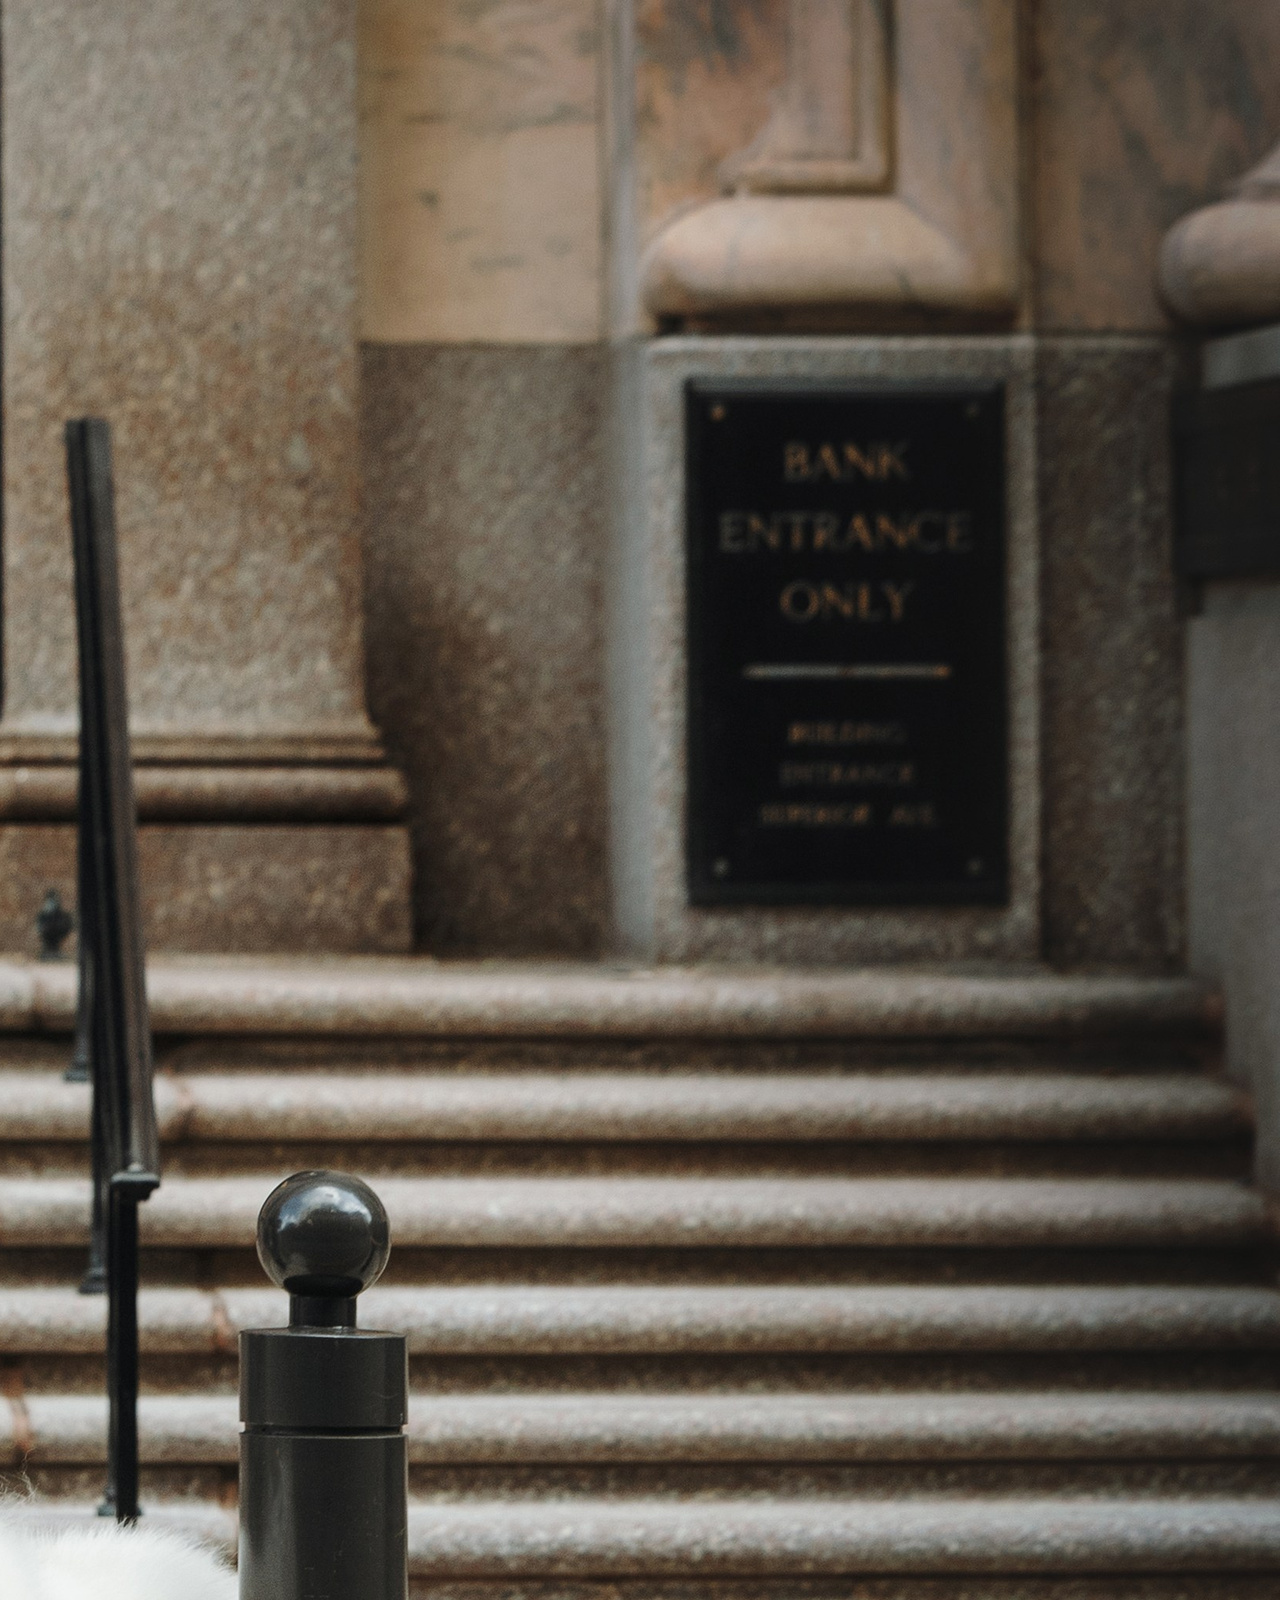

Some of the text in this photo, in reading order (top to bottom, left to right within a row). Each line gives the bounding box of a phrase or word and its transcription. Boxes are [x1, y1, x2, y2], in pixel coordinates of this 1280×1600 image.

[783, 441, 911, 481] BANK
[718, 511, 974, 553] ENTRANCE
[779, 581, 914, 621] ONLY
